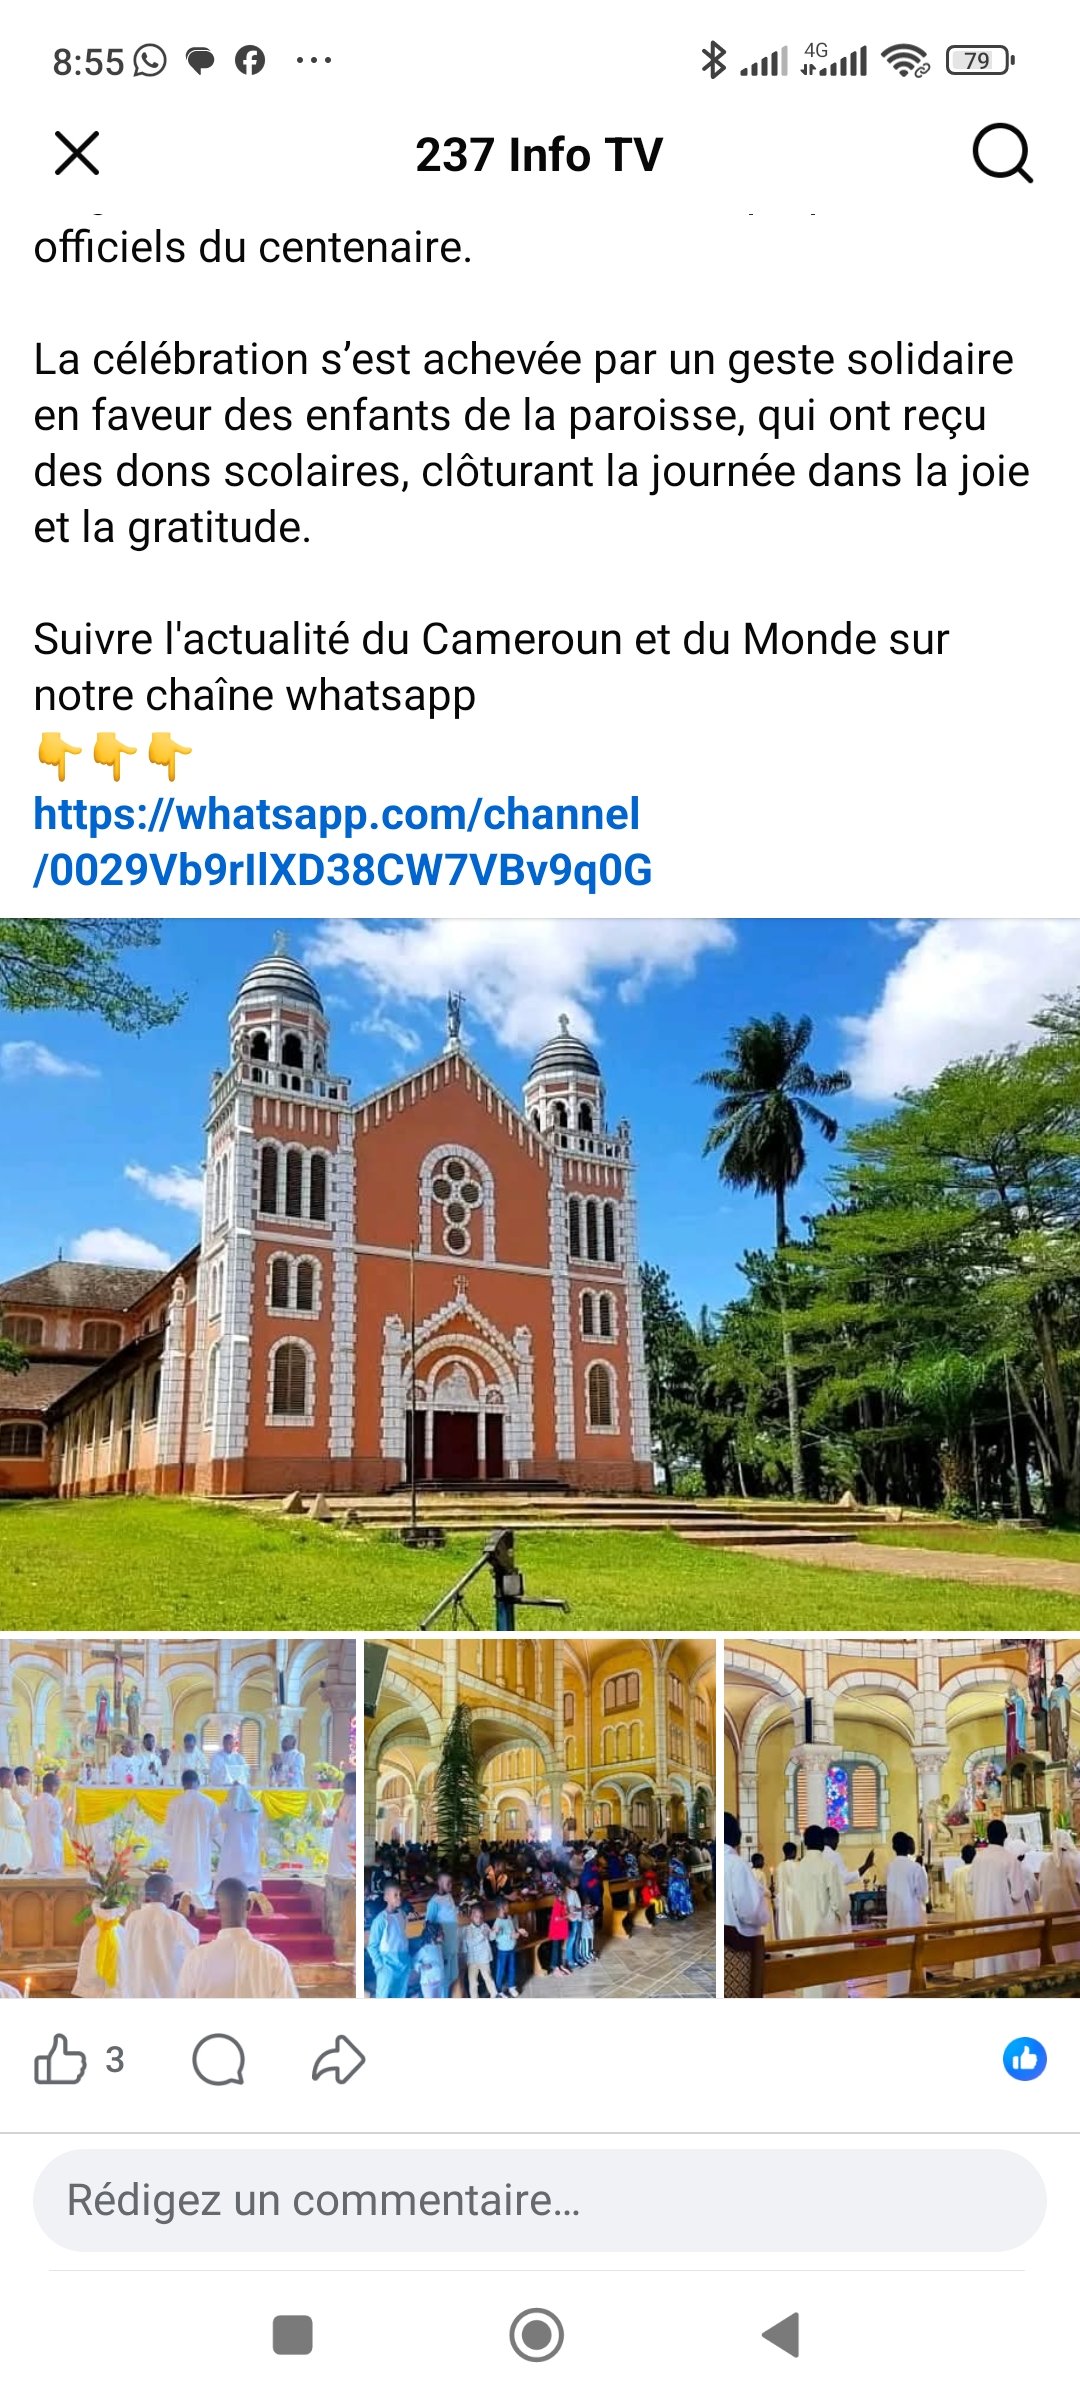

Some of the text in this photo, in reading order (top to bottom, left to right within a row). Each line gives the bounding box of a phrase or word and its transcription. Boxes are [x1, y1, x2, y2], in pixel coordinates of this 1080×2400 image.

[53, 47, 125, 77] 8:55
[803, 41, 828, 58] 4G
[964, 51, 990, 70] 79
[415, 134, 665, 173] 237 Info TV
[34, 227, 471, 264] officiels du centenaire.
[35, 341, 80, 376] La
[93, 340, 308, 376] célébration
[423, 340, 582, 376] achevée
[595, 349, 658, 384] par
[670, 349, 715, 376] un
[728, 344, 835, 384] geste
[847, 340, 1014, 376] solidaire
[34, 395, 985, 441] en faveur des enfants de la paroisse, qui ont reçu
[34, 452, 1030, 497] des dons scolaires, clôturant la journée dans la joie
[34, 508, 310, 552] et la gratitude.
[34, 620, 951, 656] Suivre l'actualité du Cameroun et du Monde sur
[35, 676, 476, 720] notre chaîne whatsapp
[34, 795, 639, 839] https://whatsapp.com/channel
[32, 851, 652, 895] /0029Vb9rIlXD38CW7VBv9q0G
[105, 2045, 125, 2073] 3
[68, 2181, 221, 2225] Rédigez
[235, 2190, 279, 2217] un
